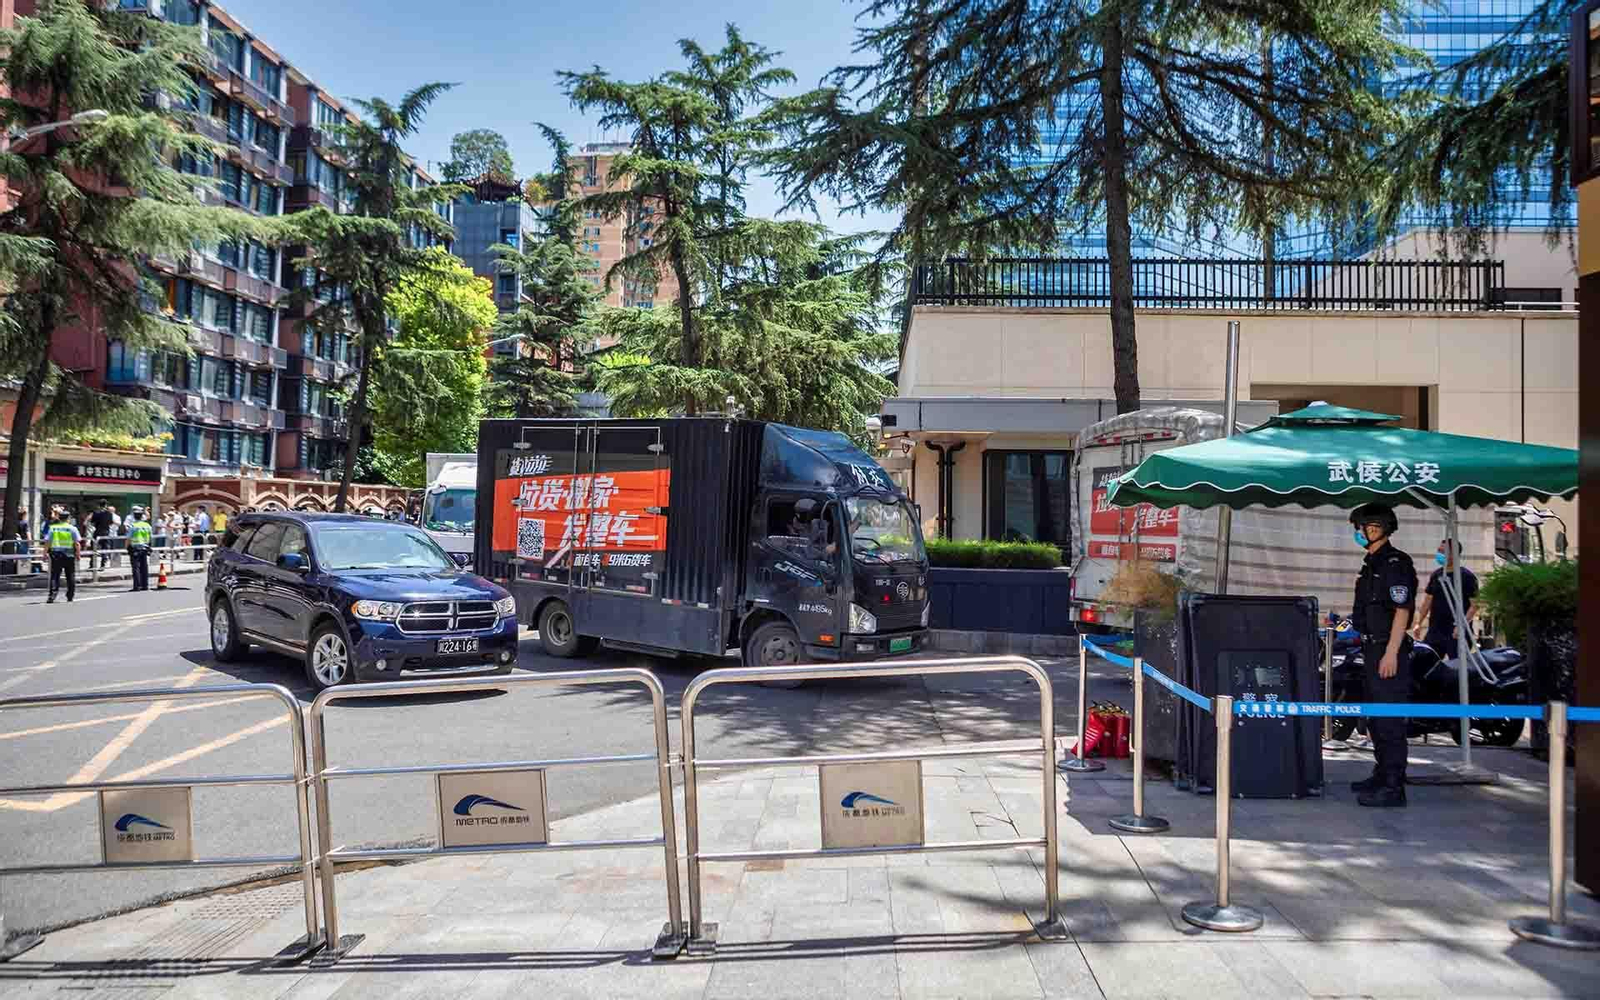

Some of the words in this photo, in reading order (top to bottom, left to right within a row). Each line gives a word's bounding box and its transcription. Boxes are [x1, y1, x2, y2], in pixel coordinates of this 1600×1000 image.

[1328, 460, 1440, 483] 武侯公安
[556, 511, 659, 552] 发整车
[1302, 705, 1332, 713] TRAFFIC
[1335, 705, 1361, 714] POLICE
